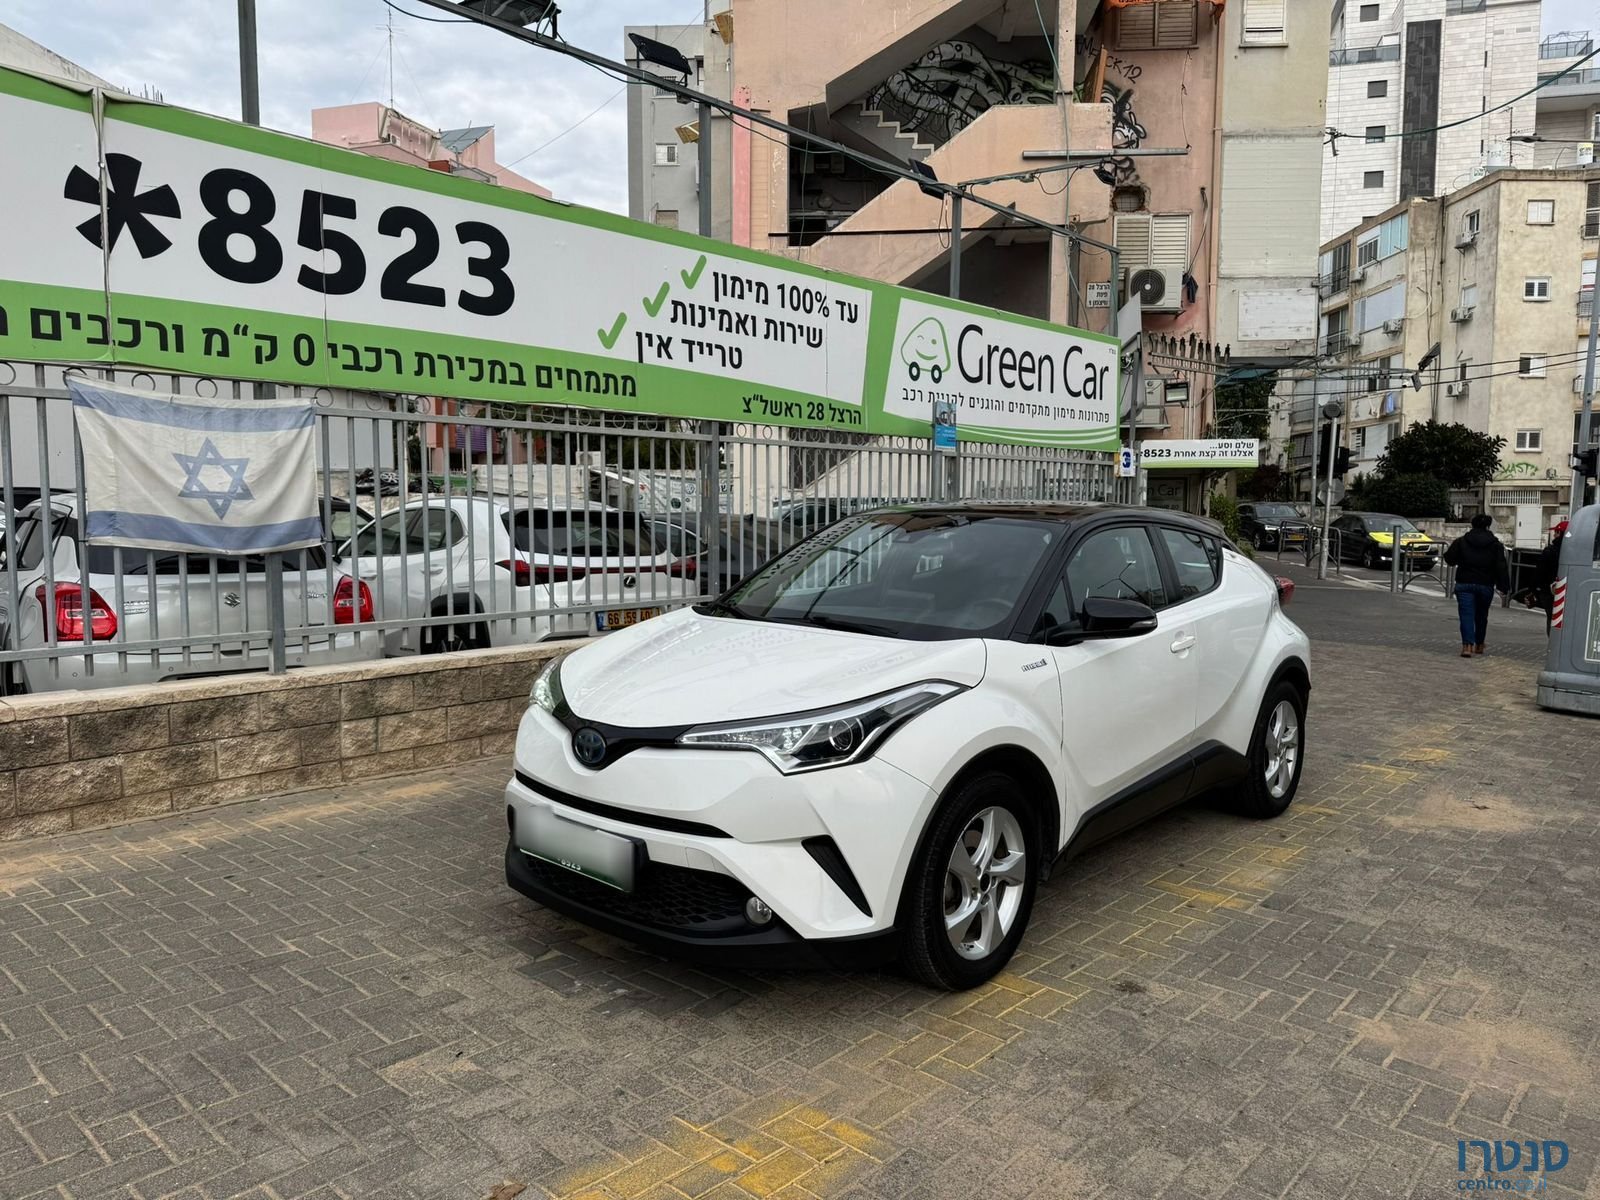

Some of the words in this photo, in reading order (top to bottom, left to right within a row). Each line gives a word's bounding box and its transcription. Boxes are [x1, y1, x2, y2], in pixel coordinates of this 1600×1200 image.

[712, 271, 769, 305] מימון
[777, 283, 830, 318] 100%
[670, 299, 757, 337] ואמינות
[835, 299, 859, 324] עד
[29, 307, 185, 353] ורכבים
[764, 317, 823, 348] שירות
[293, 333, 315, 367] 0
[326, 342, 403, 375] רכבי
[635, 331, 673, 364] אין
[681, 338, 743, 369] טרייד
[413, 352, 527, 386] במכירת
[957, 323, 1055, 394] Green
[1062, 345, 1109, 401] Car
[535, 364, 637, 397] מתמחים
[902, 387, 923, 402] רכב
[969, 396, 1005, 412] והוגנים
[806, 401, 825, 420] 28
[828, 403, 861, 425] הרצל
[1008, 401, 1050, 418] מתקדמים
[1053, 406, 1075, 420] מימון
[1078, 409, 1110, 423] פתרונות
[1173, 450, 1197, 458] אחרת
[1198, 450, 1217, 459] קצת
[1230, 449, 1254, 457] אצלנו
[1235, 441, 1254, 449] שלם
[1158, 484, 1181, 496] Car
